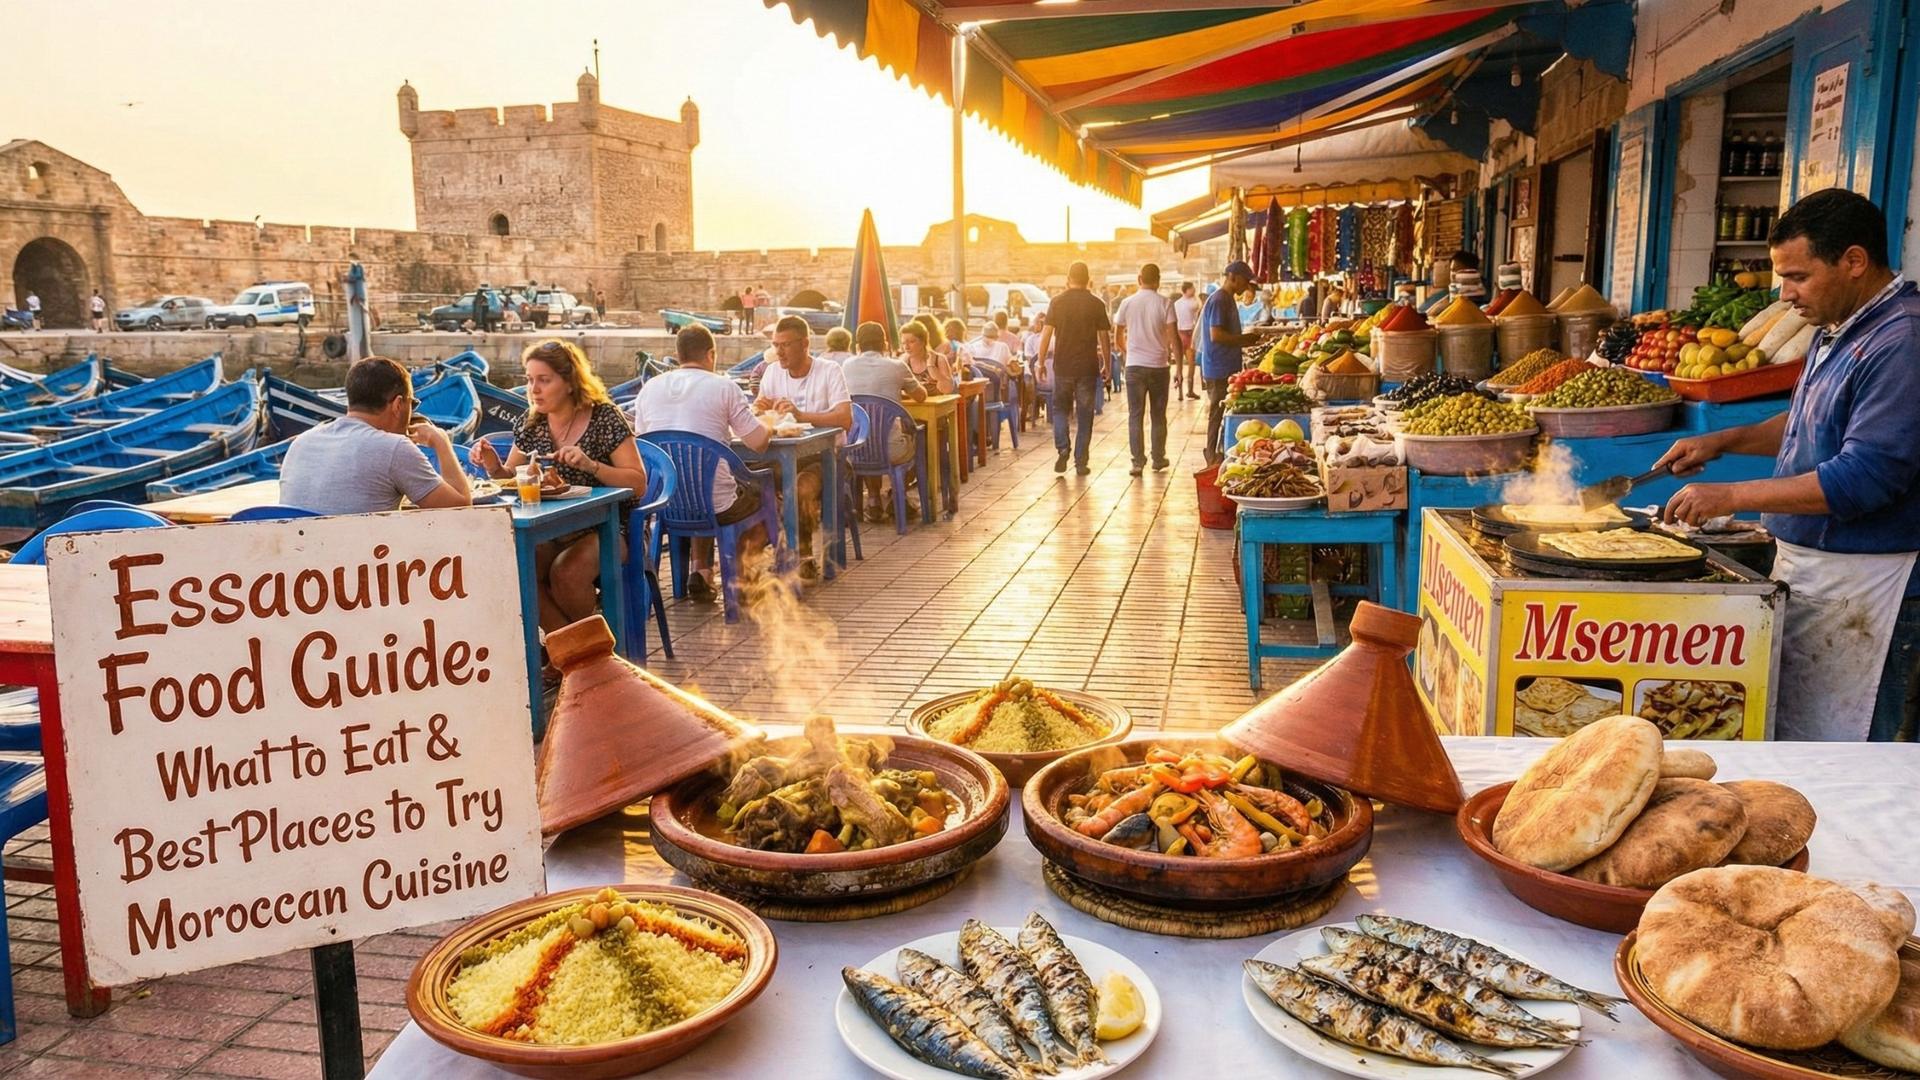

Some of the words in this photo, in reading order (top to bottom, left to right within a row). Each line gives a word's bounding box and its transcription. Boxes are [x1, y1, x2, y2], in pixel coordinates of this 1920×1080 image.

[109, 544, 468, 640] Essaouira
[1424, 533, 1484, 657] Msemen
[1515, 603, 1747, 666] Msemen
[98, 638, 265, 735] Food
[291, 618, 491, 709] Guide:
[157, 739, 283, 801] What
[284, 735, 326, 779] to
[340, 720, 421, 775] Eat
[427, 714, 462, 761] &
[114, 819, 231, 884] Best
[231, 808, 375, 863] Places
[385, 789, 426, 833] to
[436, 779, 503, 832] Try
[128, 887, 347, 955] Moroccan
[363, 852, 509, 910] Cuisine
